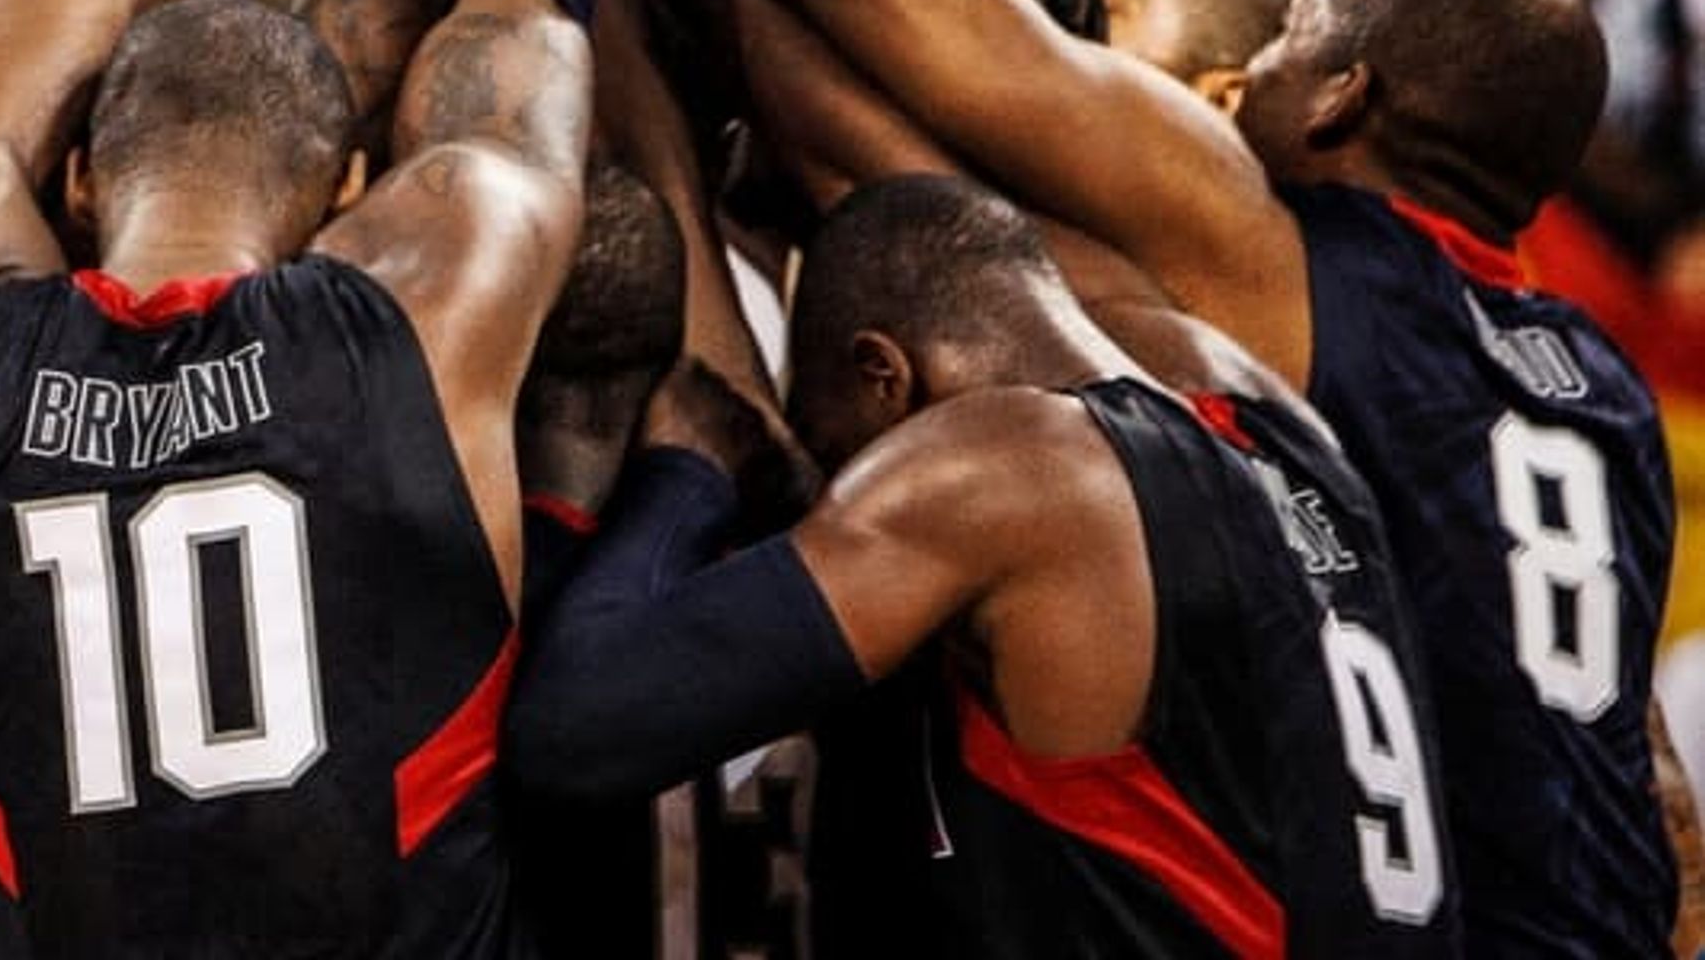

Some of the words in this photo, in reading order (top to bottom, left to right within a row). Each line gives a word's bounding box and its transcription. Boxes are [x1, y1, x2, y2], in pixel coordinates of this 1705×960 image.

[23, 342, 272, 468] BRYANT
[11, 470, 329, 814] 10
[1489, 410, 1620, 724] 8
[1320, 610, 1444, 926] 9
